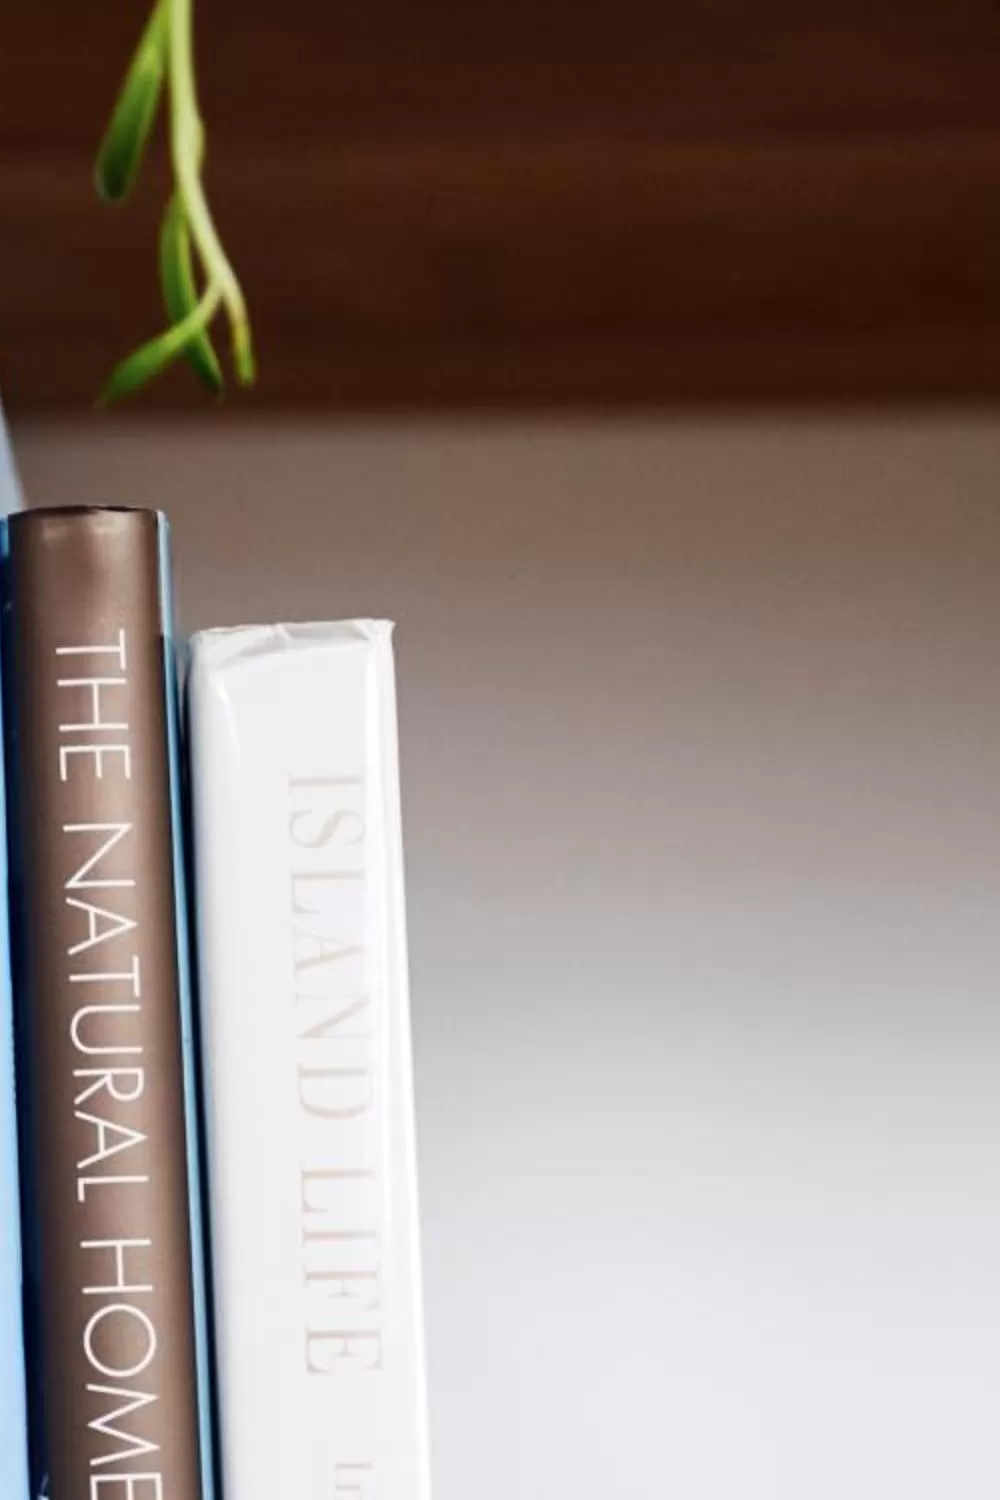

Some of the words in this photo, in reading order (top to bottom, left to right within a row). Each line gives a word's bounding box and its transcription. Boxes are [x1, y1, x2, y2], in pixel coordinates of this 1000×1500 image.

[56, 628, 131, 781] THE
[63, 822, 149, 1202] NATURAL
[288, 773, 374, 1120] ISLAND
[301, 1160, 383, 1376] LIFE
